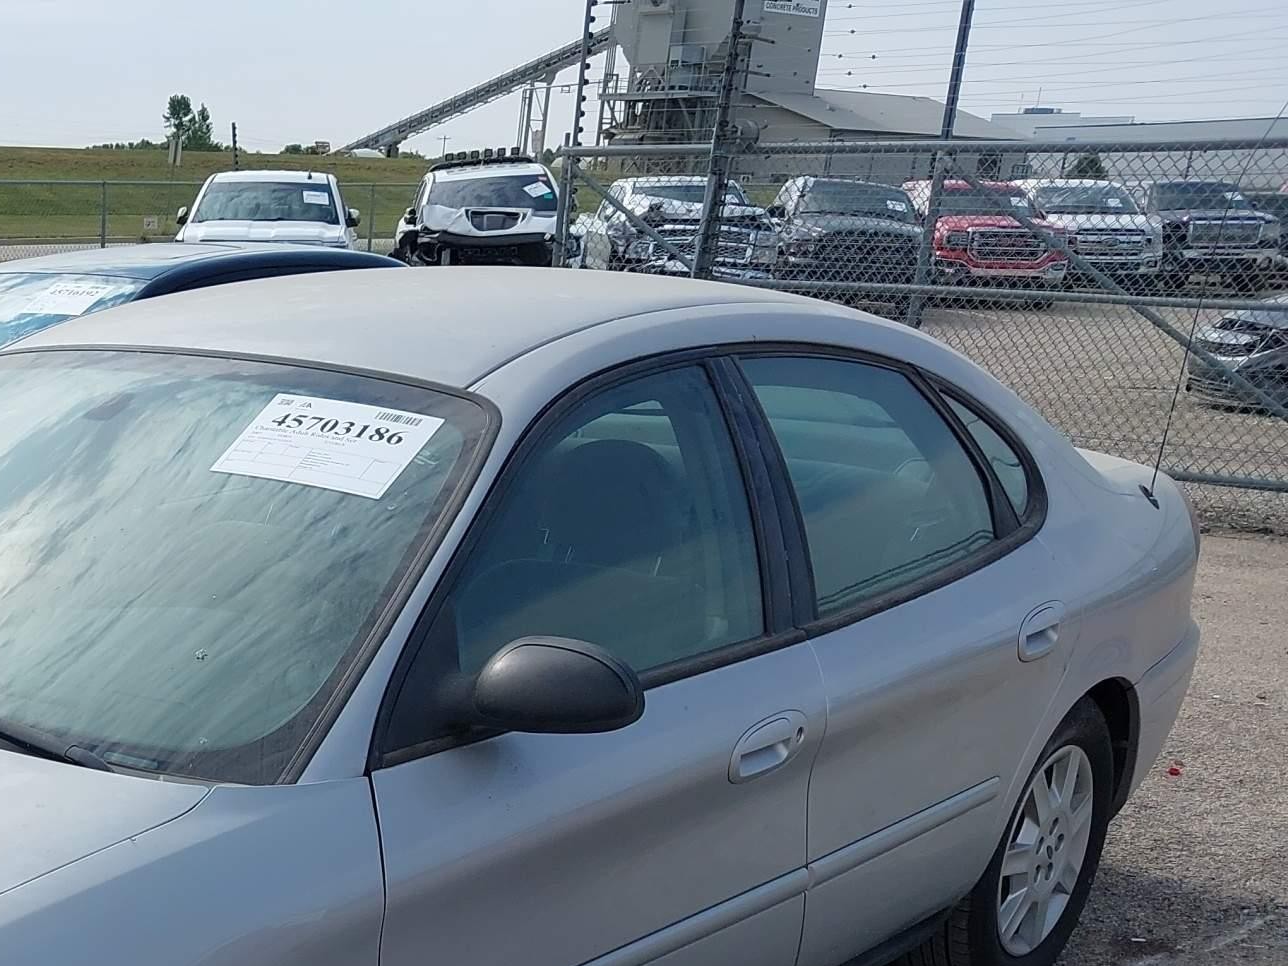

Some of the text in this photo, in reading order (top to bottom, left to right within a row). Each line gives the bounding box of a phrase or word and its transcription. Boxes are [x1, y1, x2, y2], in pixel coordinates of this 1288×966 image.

[765, 2, 818, 15] CONCRETE PRODUCTS
[271, 413, 409, 446] 45703186
